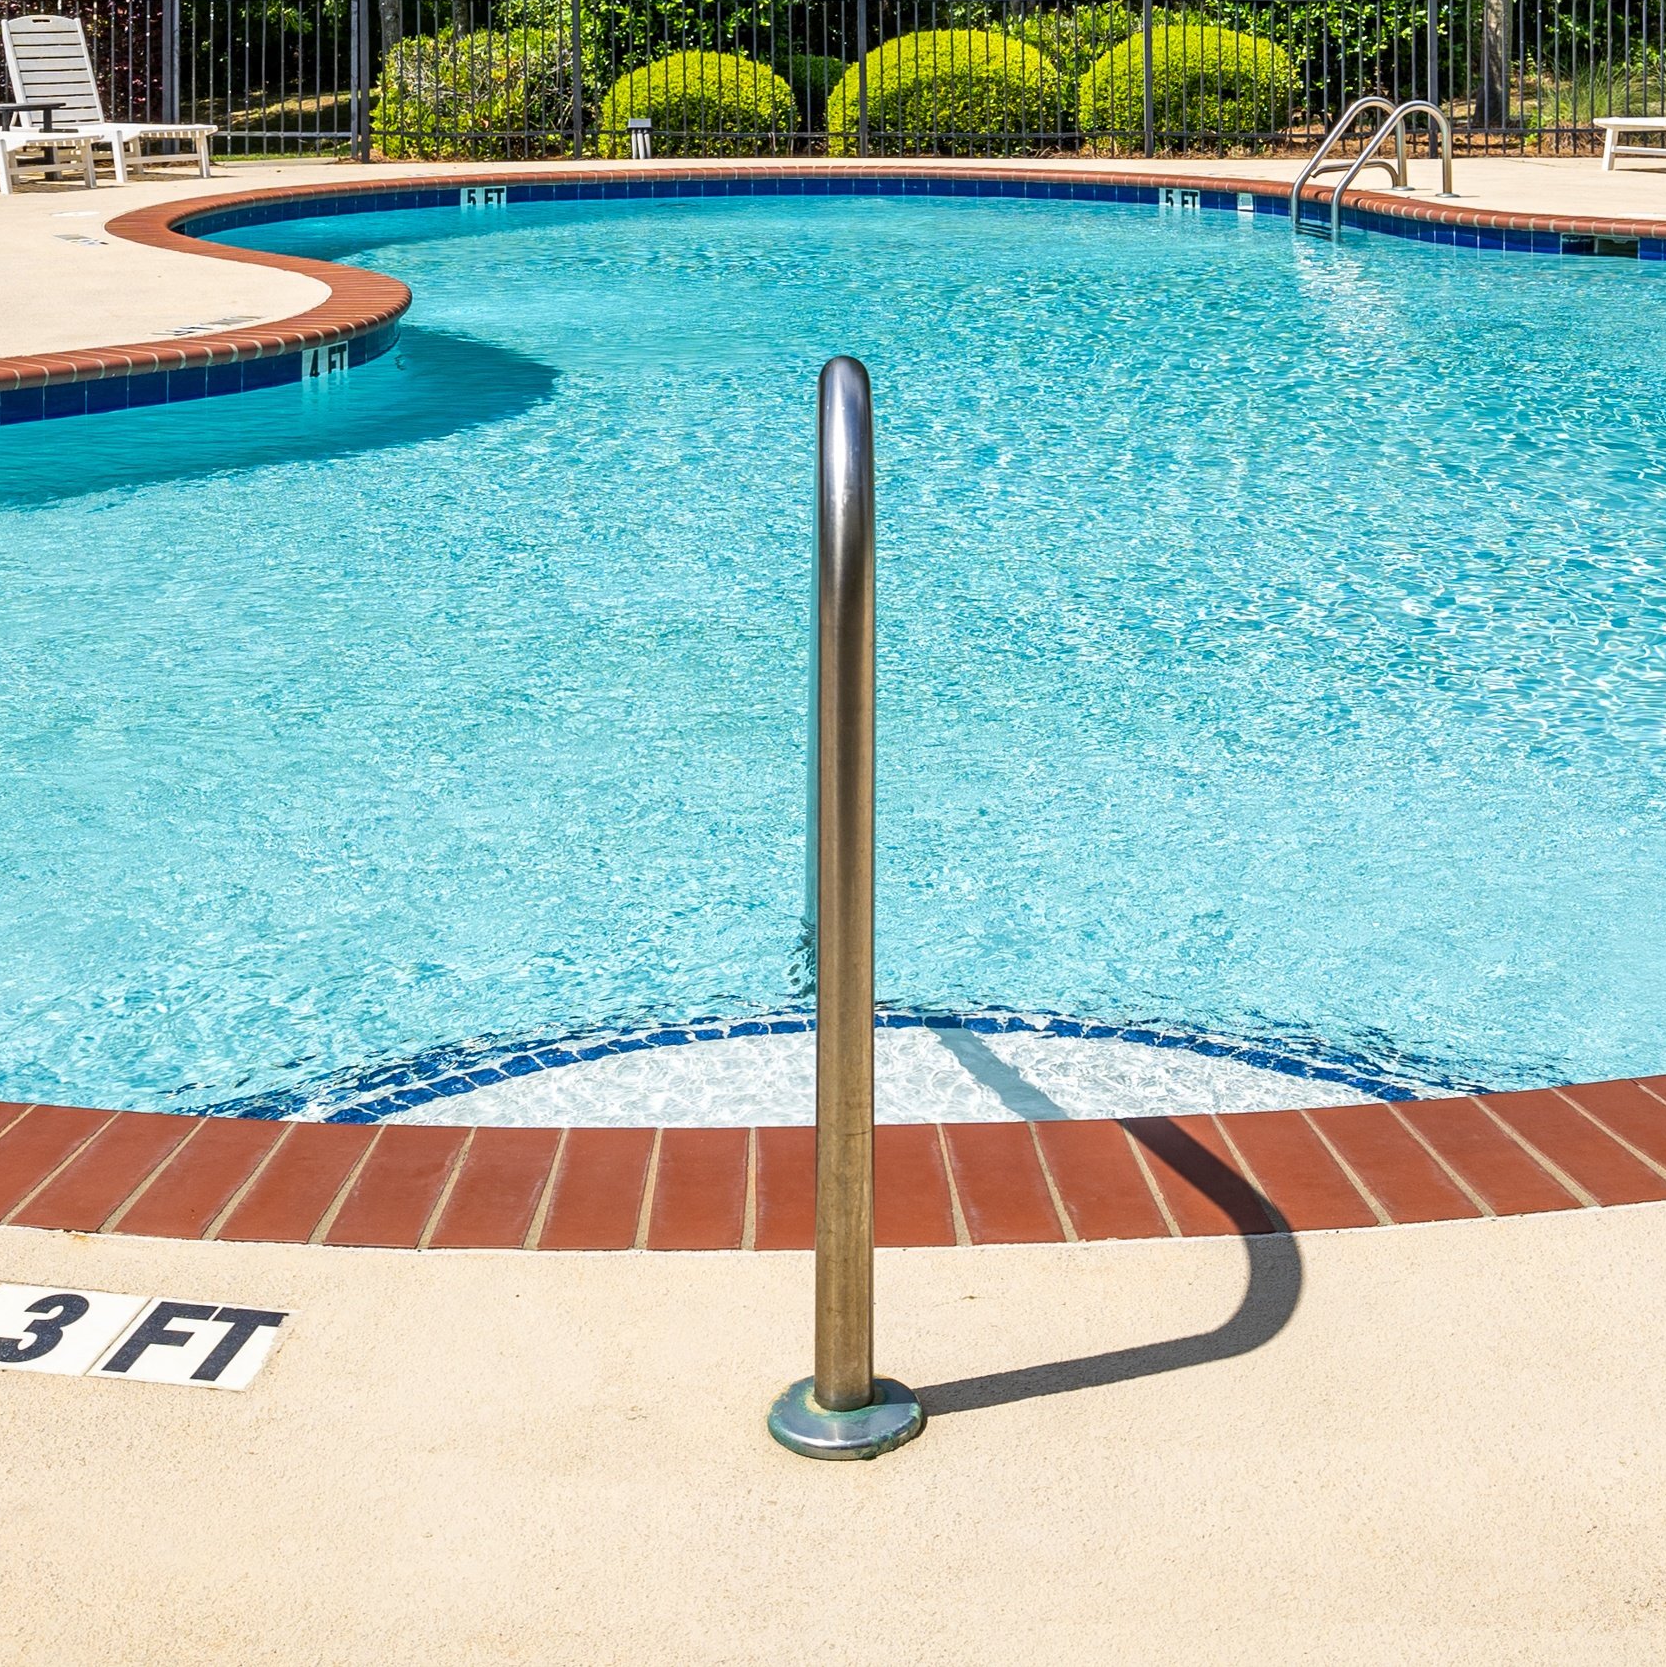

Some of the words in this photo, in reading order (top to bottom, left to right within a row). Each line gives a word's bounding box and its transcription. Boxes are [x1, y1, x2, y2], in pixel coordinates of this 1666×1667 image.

[467, 189, 477, 205] 5
[484, 188, 505, 204] FT
[1165, 189, 1174, 206] 5
[1181, 191, 1198, 207] FT
[309, 349, 320, 377] 4
[328, 343, 347, 374] FT
[101, 1300, 291, 1383] FT
